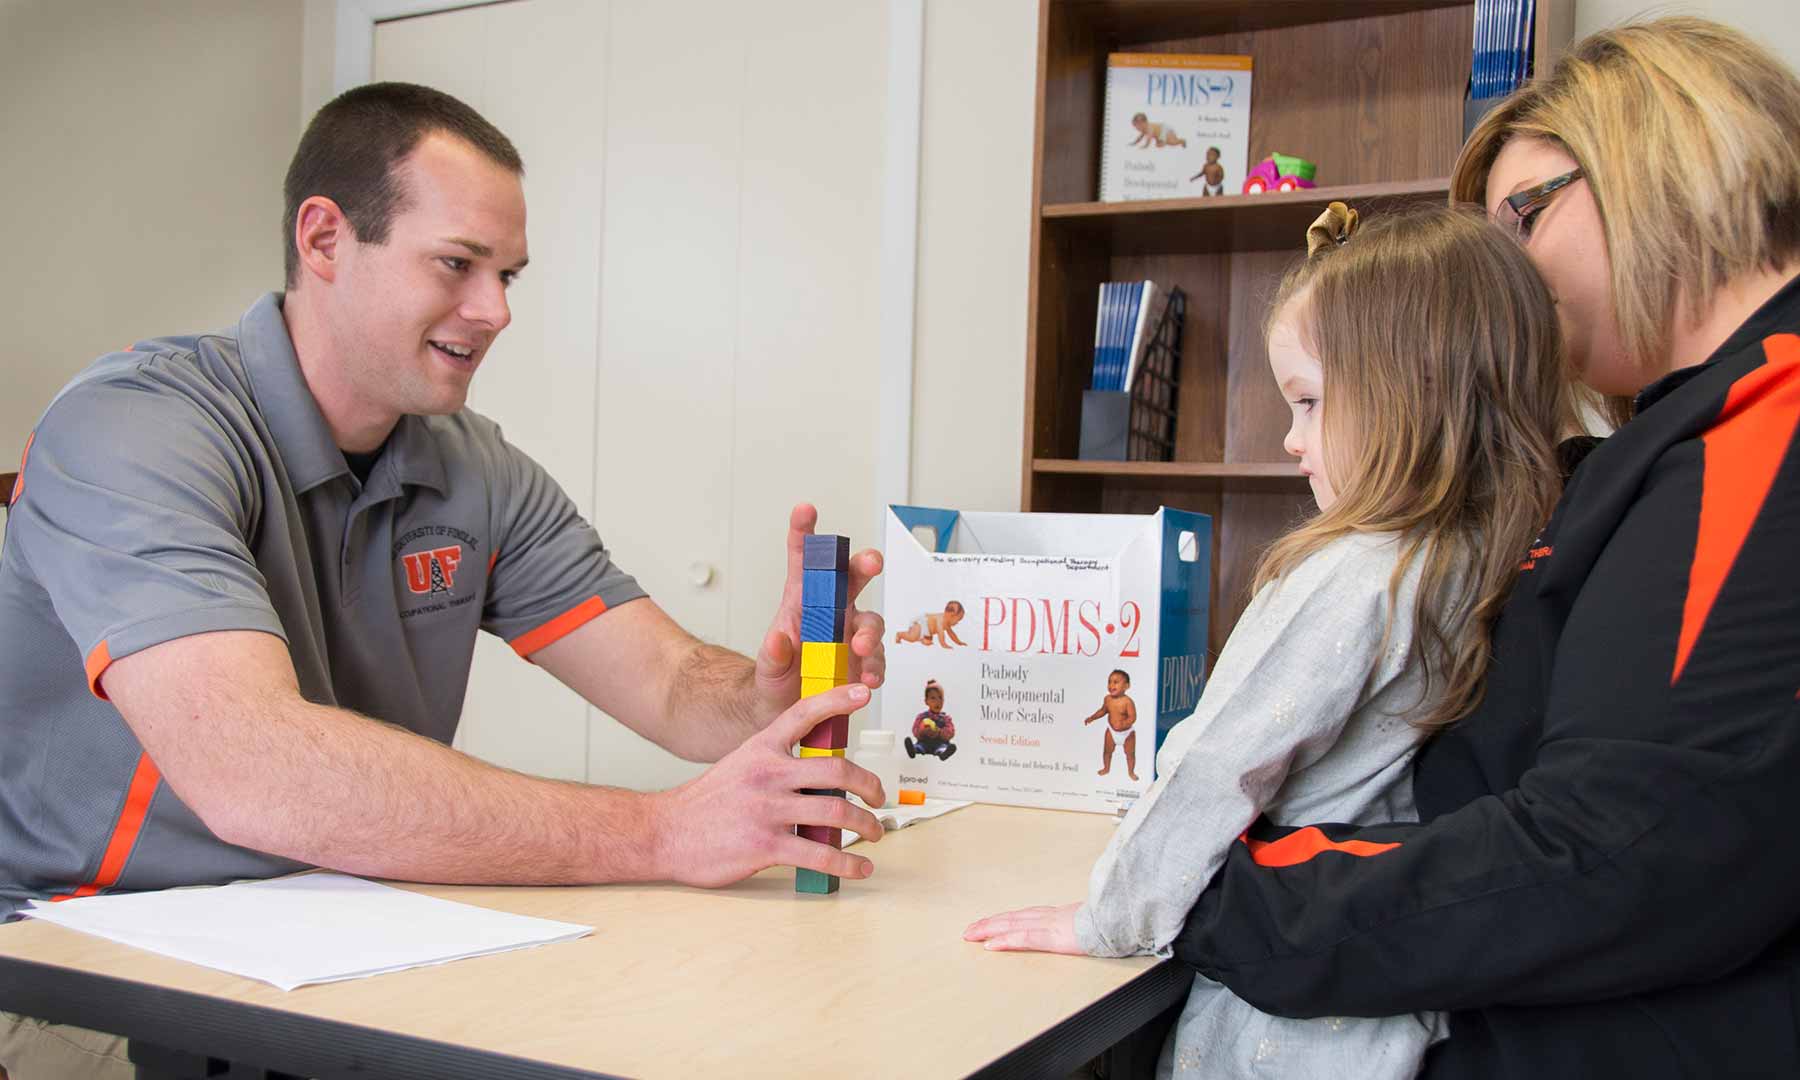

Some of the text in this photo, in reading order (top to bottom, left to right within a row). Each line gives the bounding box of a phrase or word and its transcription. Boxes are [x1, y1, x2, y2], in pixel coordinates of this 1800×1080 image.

[402, 544, 462, 594] UF
[981, 663, 1030, 683] Peabody
[980, 684, 1065, 704] Developmental
[980, 705, 1055, 725] Motor Scales
[979, 735, 1041, 747] Second Edition
